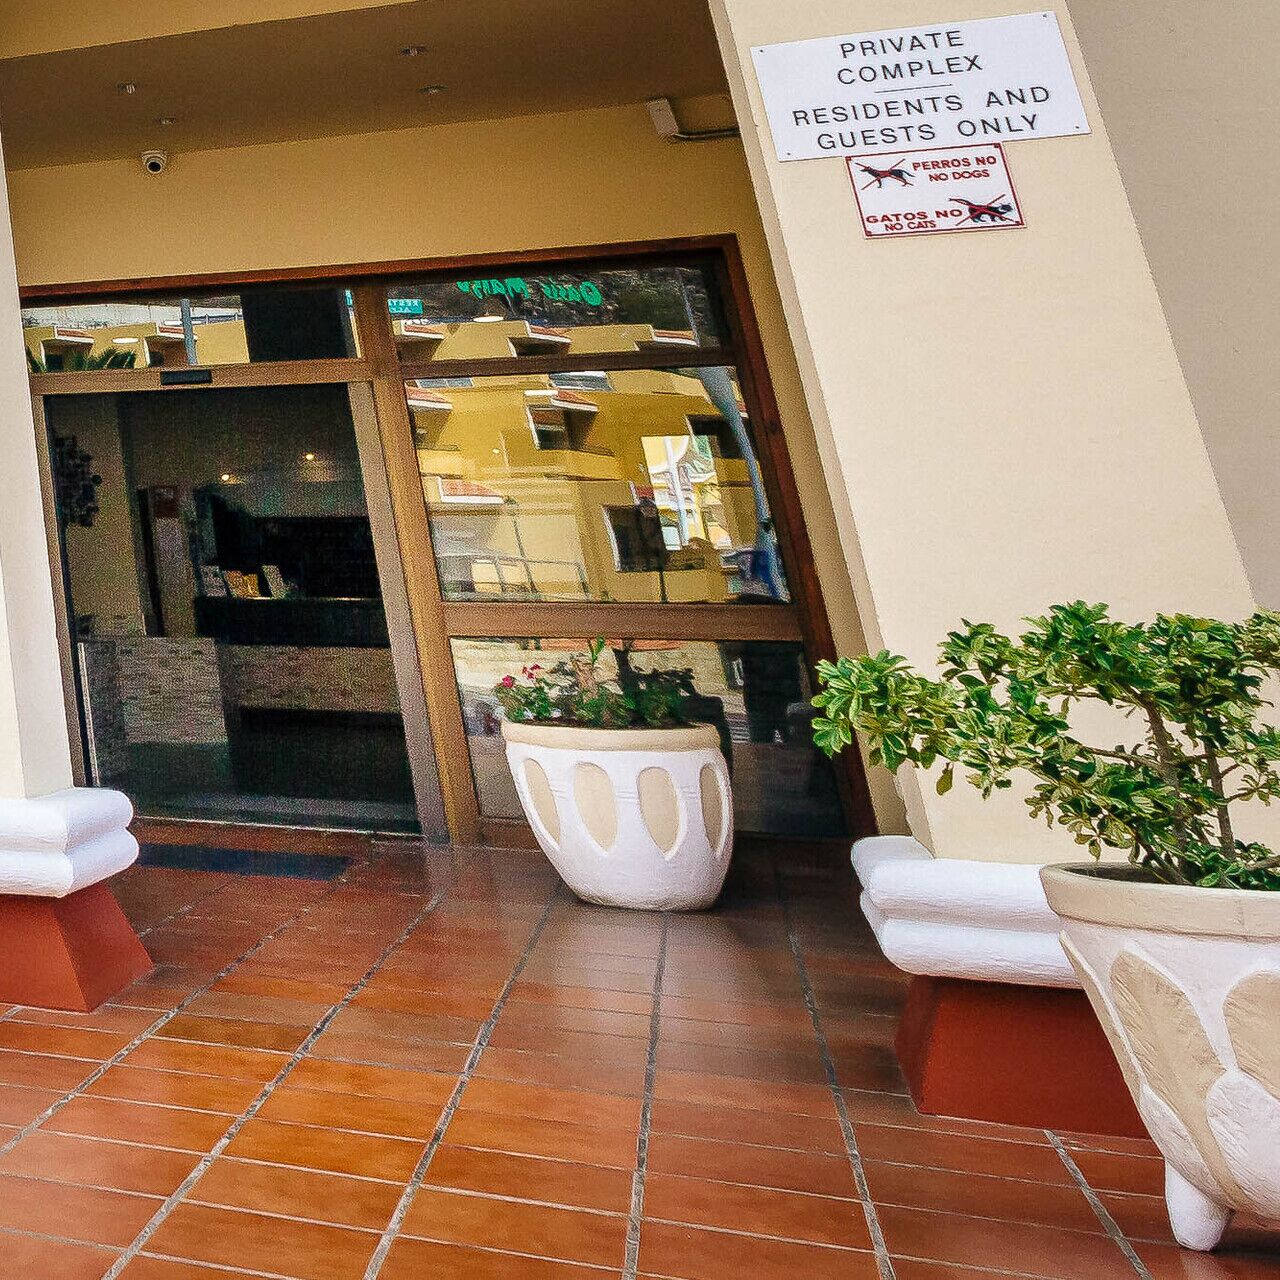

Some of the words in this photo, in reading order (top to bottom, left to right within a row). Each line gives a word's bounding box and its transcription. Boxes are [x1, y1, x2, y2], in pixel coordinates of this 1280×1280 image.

[840, 30, 964, 59] PRIVATE
[837, 55, 983, 85] COMPLEX
[792, 95, 964, 126] RESIDENTS
[985, 86, 1050, 108] AND
[817, 124, 936, 150] GUESTS
[958, 114, 1038, 137] ONLY
[912, 157, 972, 171] PERROS
[975, 156, 997, 166] NO
[928, 172, 949, 182] NO
[953, 169, 990, 180] DOGS
[866, 211, 928, 224] GATOS
[935, 209, 963, 219] NO
[884, 222, 904, 232] NO
[907, 220, 937, 231] CATS
